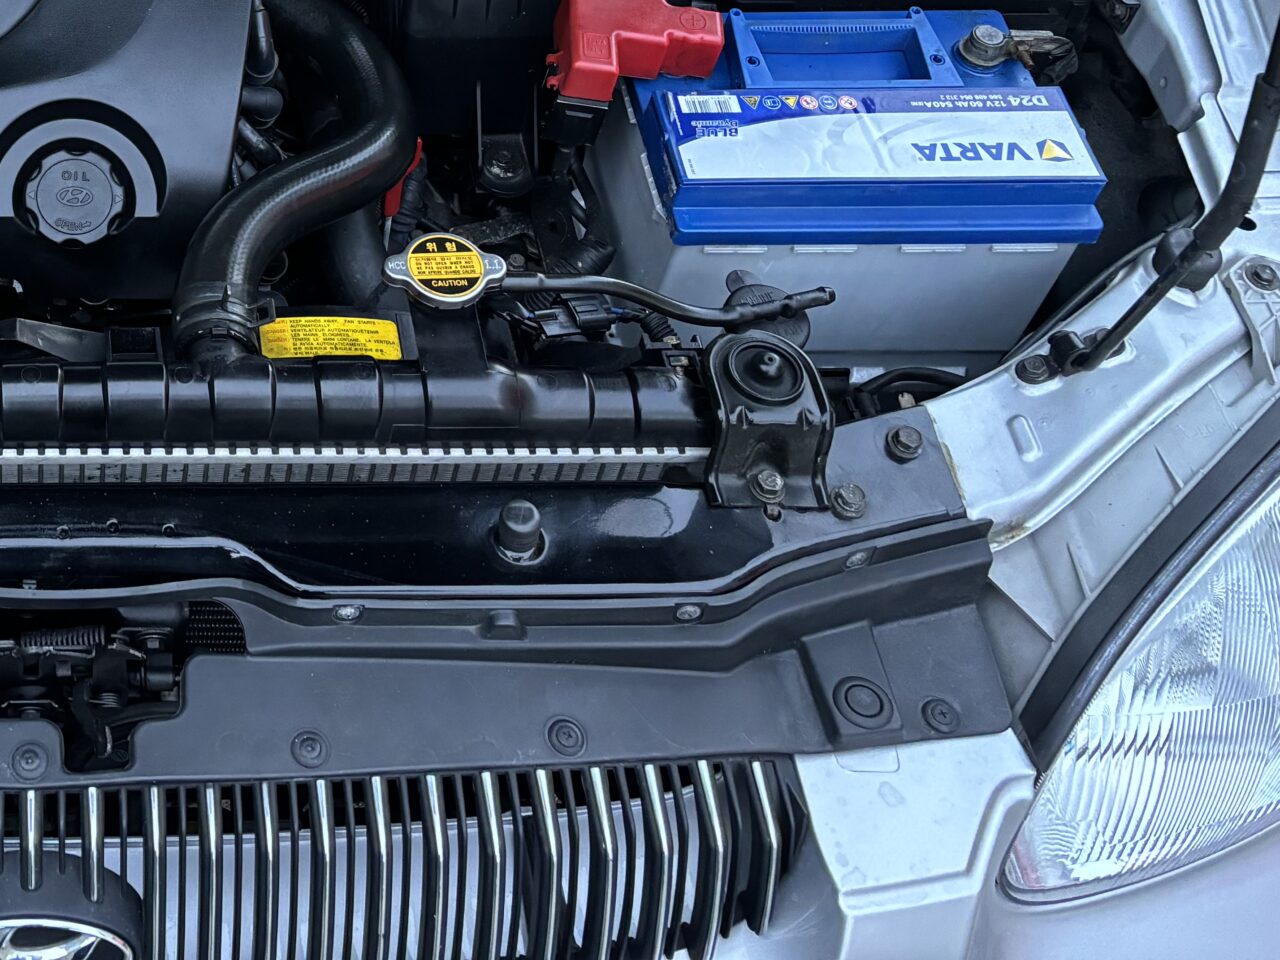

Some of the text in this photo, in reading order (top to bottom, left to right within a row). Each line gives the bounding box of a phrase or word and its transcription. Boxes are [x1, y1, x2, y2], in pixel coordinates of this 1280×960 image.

[986, 100, 1007, 108] 12V
[1006, 95, 1049, 107] D24
[690, 119, 739, 128] Dynamic
[695, 127, 739, 138] BLUE
[910, 142, 1034, 161] VARTA
[61, 170, 90, 182] OIL
[388, 261, 406, 270] HCC
[431, 279, 468, 288] CAUTION
